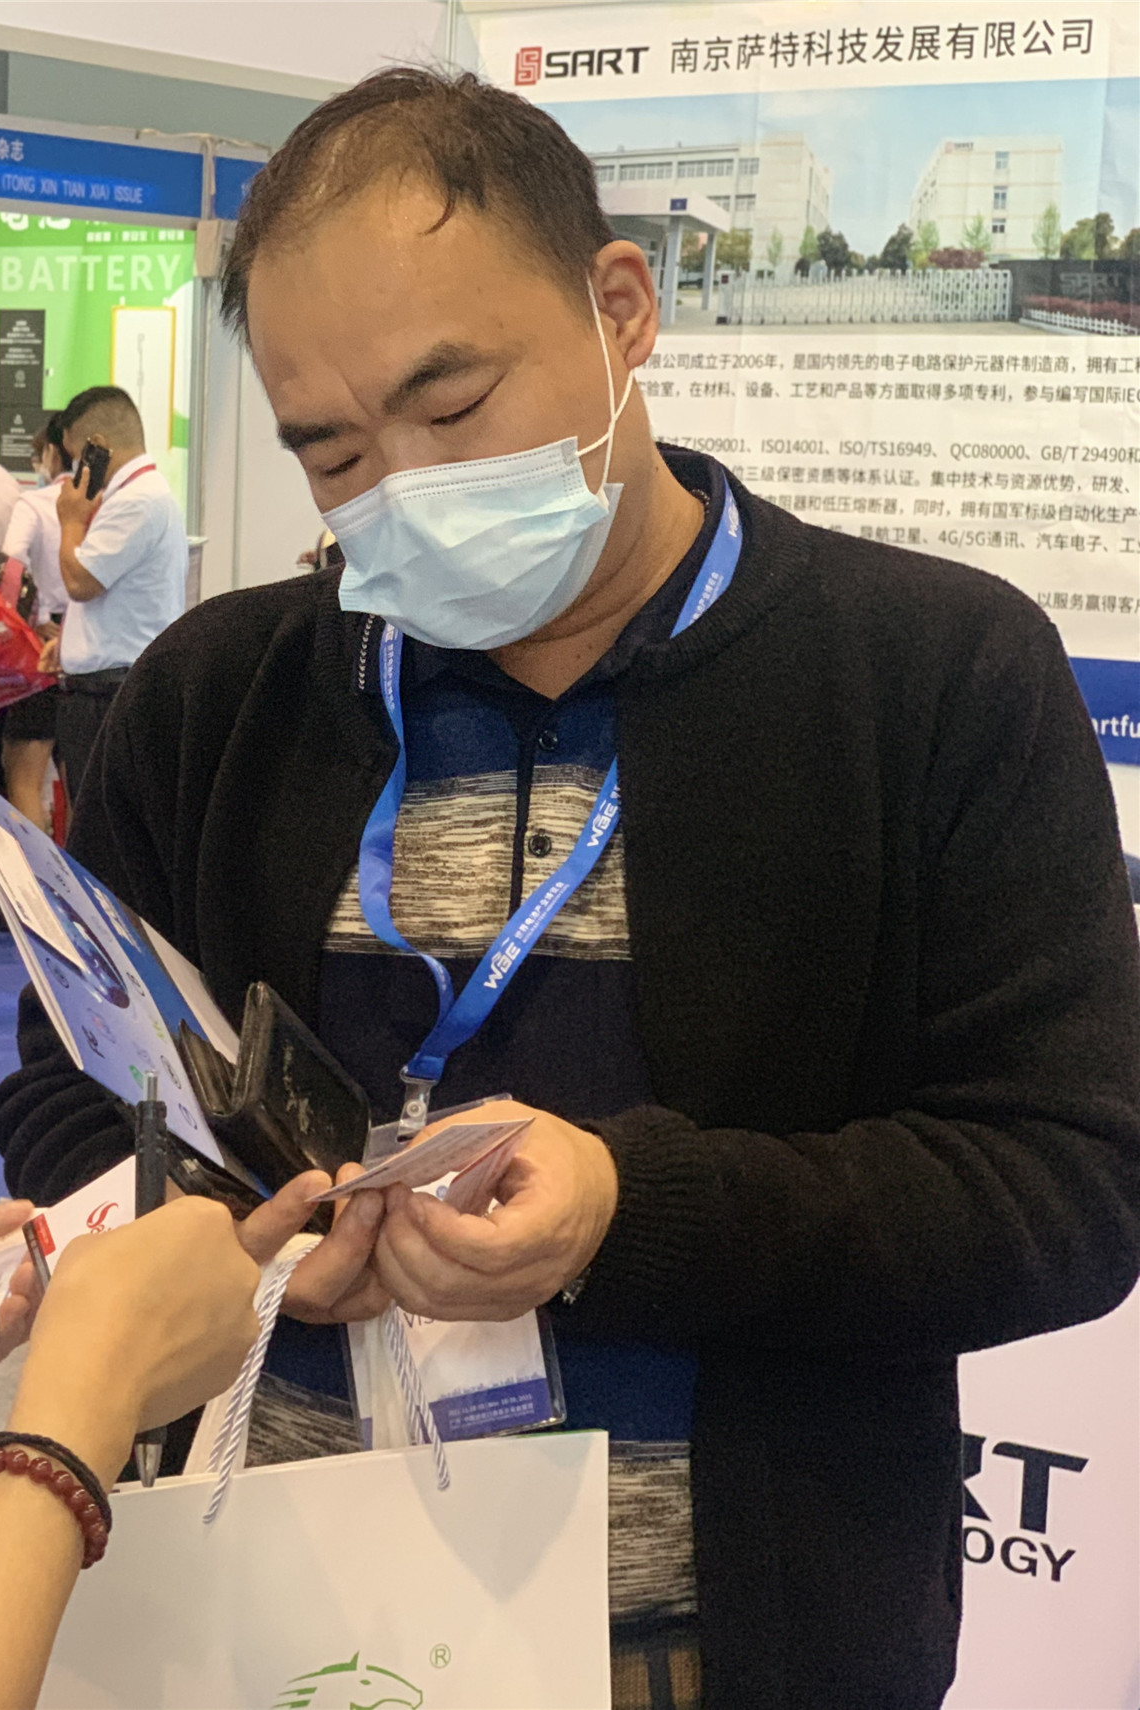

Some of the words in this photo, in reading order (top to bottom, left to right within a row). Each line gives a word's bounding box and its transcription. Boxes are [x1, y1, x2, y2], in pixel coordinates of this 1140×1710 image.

[544, 46, 650, 78] SART
[670, 19, 1094, 74] 南京萨特科技发展有限公司
[41, 179, 58, 196] XIN
[63, 180, 85, 198] TIAN
[114, 186, 144, 204] ISSUE
[1, 254, 181, 291] BATTERY
[961, 1526, 1076, 1582] OGY
